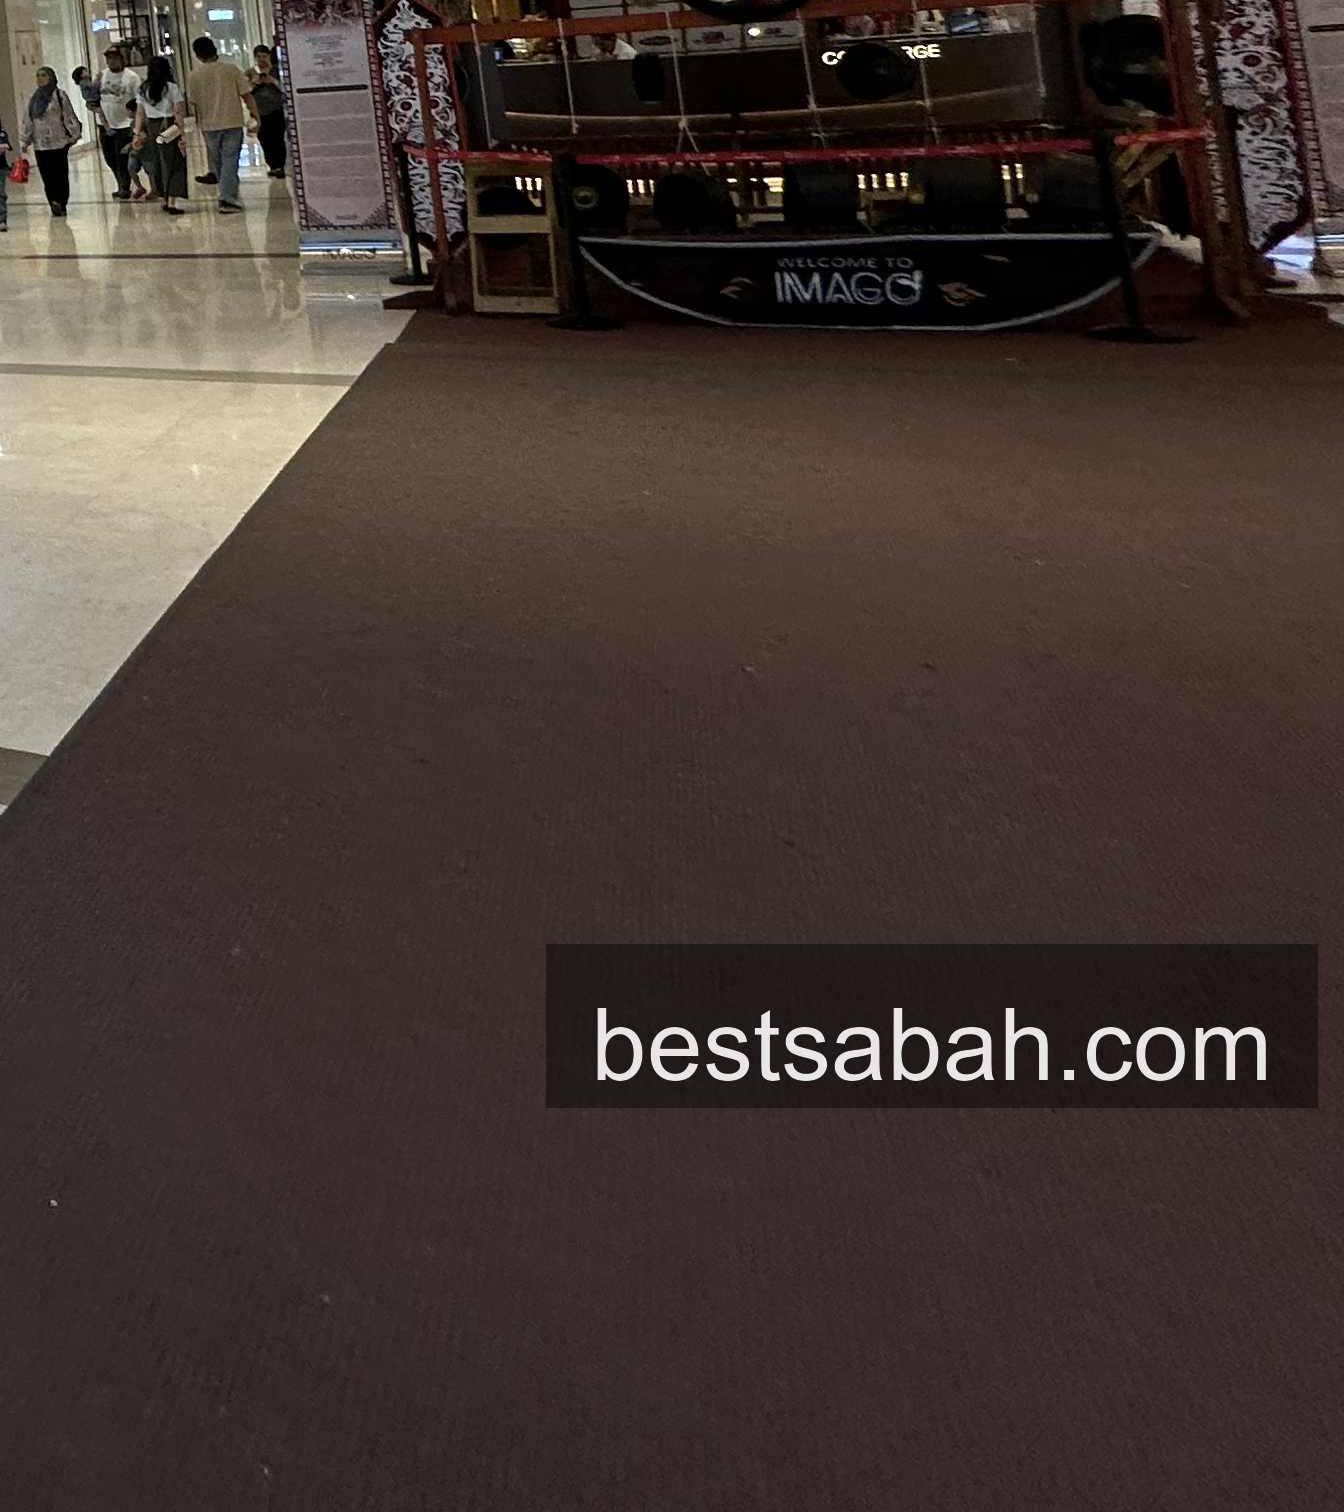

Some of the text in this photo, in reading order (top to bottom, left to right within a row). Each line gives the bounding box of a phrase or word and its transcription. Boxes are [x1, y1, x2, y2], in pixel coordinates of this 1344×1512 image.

[776, 257, 914, 269] WELCOME TO
[773, 270, 924, 306] IMAGO
